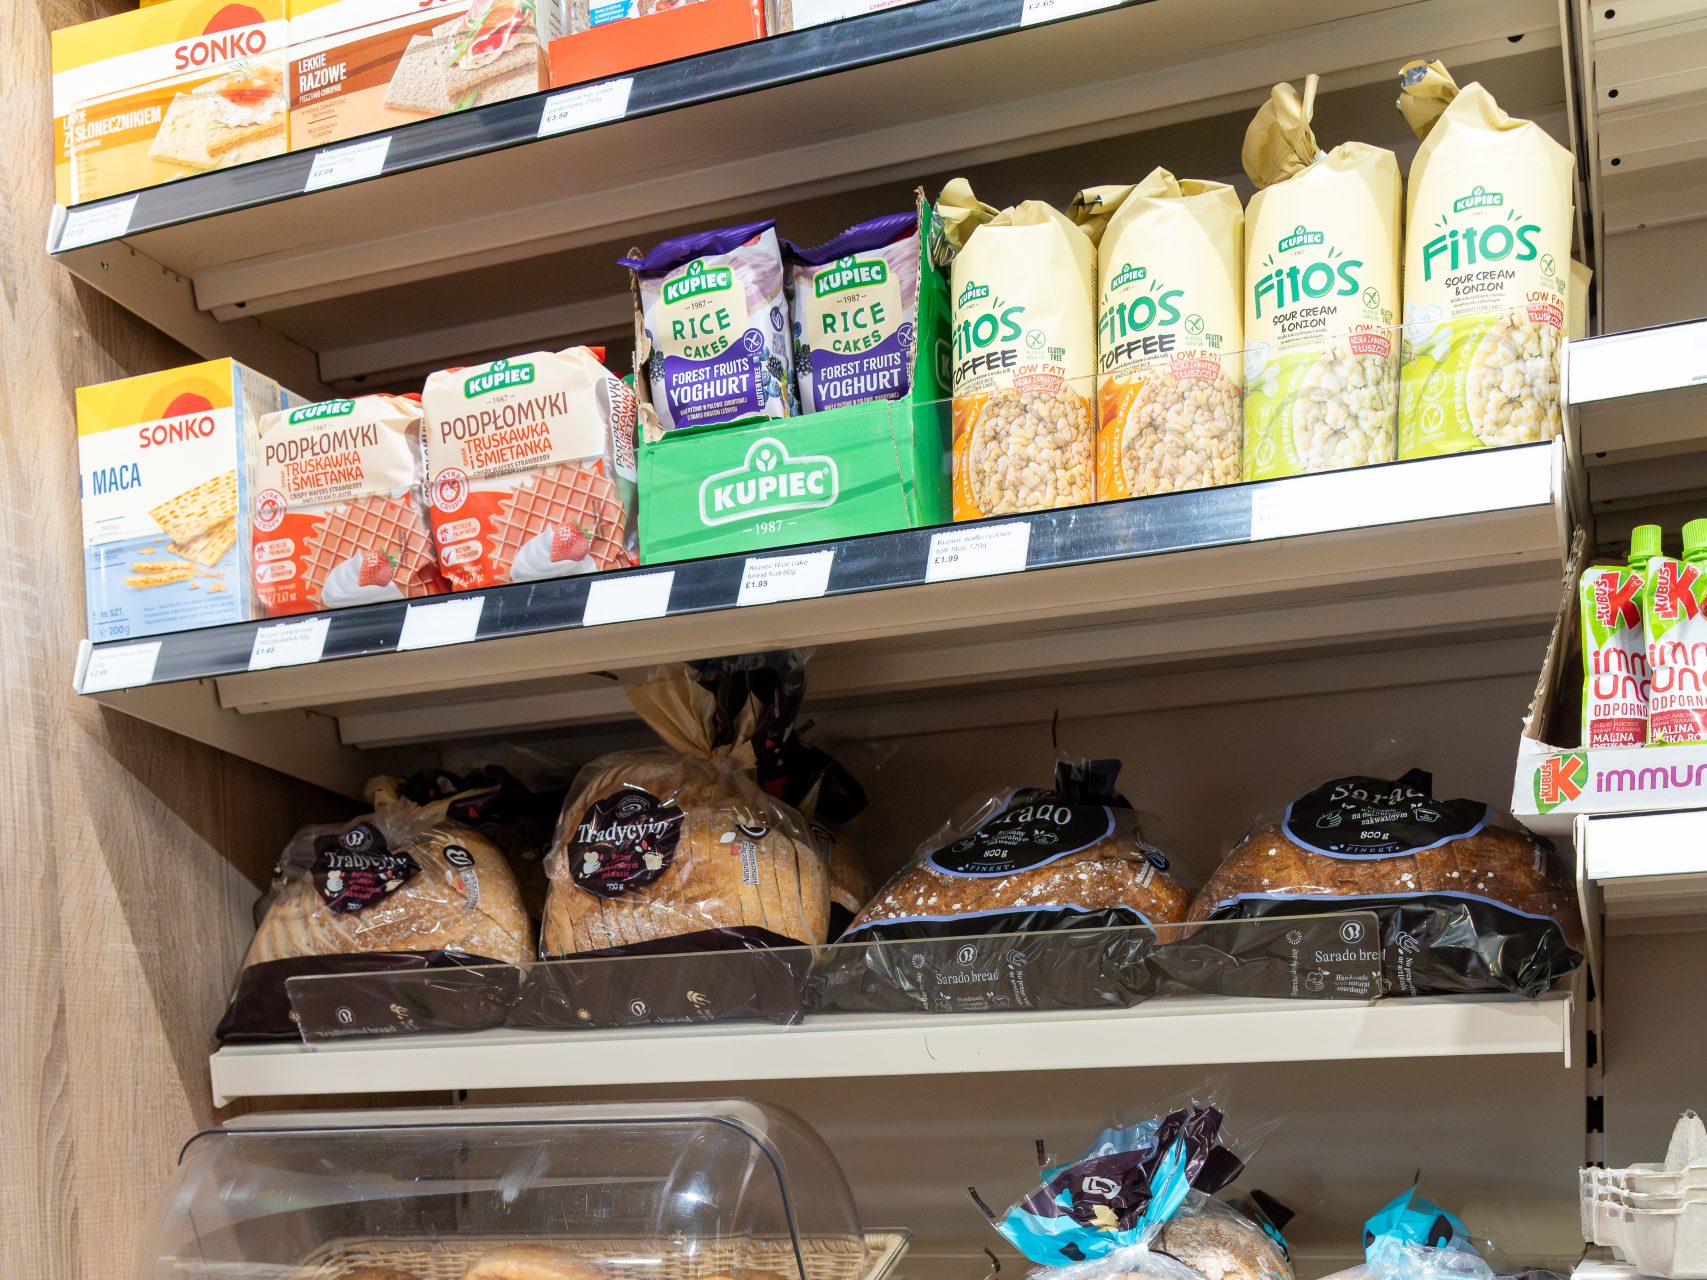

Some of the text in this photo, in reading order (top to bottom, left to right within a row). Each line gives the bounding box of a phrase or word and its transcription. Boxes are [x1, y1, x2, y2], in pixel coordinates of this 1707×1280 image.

[175, 30, 267, 70] SONKO
[298, 53, 327, 74] LEKKIE
[299, 62, 348, 93] RAZOWE
[75, 106, 162, 142] SŁONECZNIKIEM
[1456, 192, 1501, 213] KUPIEC
[1281, 232, 1322, 250] KUPIEC
[667, 272, 728, 301] KUPIEC
[818, 265, 883, 294] KUPIEC
[1113, 269, 1145, 289] KUPIEC
[1444, 270, 1516, 289] SOUR CREAM
[1455, 281, 1504, 296] & ONION
[691, 300, 707, 310] 1987
[843, 294, 861, 303] 1987
[959, 287, 988, 306] KUPIEC
[1526, 291, 1549, 302] LOW
[671, 308, 731, 340] RICE
[822, 302, 886, 334] RICE
[1272, 305, 1338, 326] SOUR CREAM
[1281, 317, 1326, 333] & ONION
[683, 335, 729, 359] CAKES
[832, 329, 882, 352] CAKES
[1047, 346, 1066, 355] GLUTEN
[1208, 340, 1221, 349] FREE
[1050, 353, 1062, 362] FREE
[1100, 333, 1176, 374] TOFFEE
[1169, 350, 1197, 362] LOW
[672, 357, 750, 384] FOREST FRUITS
[820, 352, 902, 381] FOREST FRUITS
[952, 349, 1018, 390] TOFFEE
[1012, 363, 1066, 378] LOW FAT!
[468, 362, 531, 394] KUPIEC
[754, 366, 765, 407] GLUTEN FREE
[817, 368, 902, 402] YOGHURT
[492, 395, 509, 405] 1987
[670, 374, 750, 407] YOGHURT
[293, 401, 352, 422] KUPIEC
[440, 391, 569, 444] PODPŁOMYKI
[607, 377, 624, 468] PODPŁOMYKI
[139, 415, 215, 449] SONKO
[463, 421, 550, 455] TRUSKAWKA
[265, 423, 379, 467] PODPŁOMYKI
[469, 437, 553, 470] i ŚMIETANKA
[284, 450, 362, 477] TRUSKAWKA
[514, 454, 551, 468] STRAWBERRY
[92, 462, 142, 496] MACA
[287, 465, 365, 492] i ŚMIETANKA
[714, 470, 825, 512] KUPIEC
[440, 497, 464, 511] CRISPY
[754, 519, 783, 535] 1987
[934, 554, 959, 565] £1.99
[745, 580, 768, 589] £1.95
[1654, 566, 1671, 614] KUBUŚ
[1596, 578, 1611, 626] KUBUŚ
[1592, 733, 1635, 743] MALINA
[1652, 723, 1695, 737] MALINA
[1540, 758, 1552, 799] KUBUŚ
[1360, 831, 1390, 840] 800 g
[983, 848, 1009, 859] 800 g
[1315, 948, 1356, 963] Sarado
[936, 970, 999, 985] Sarado bread
